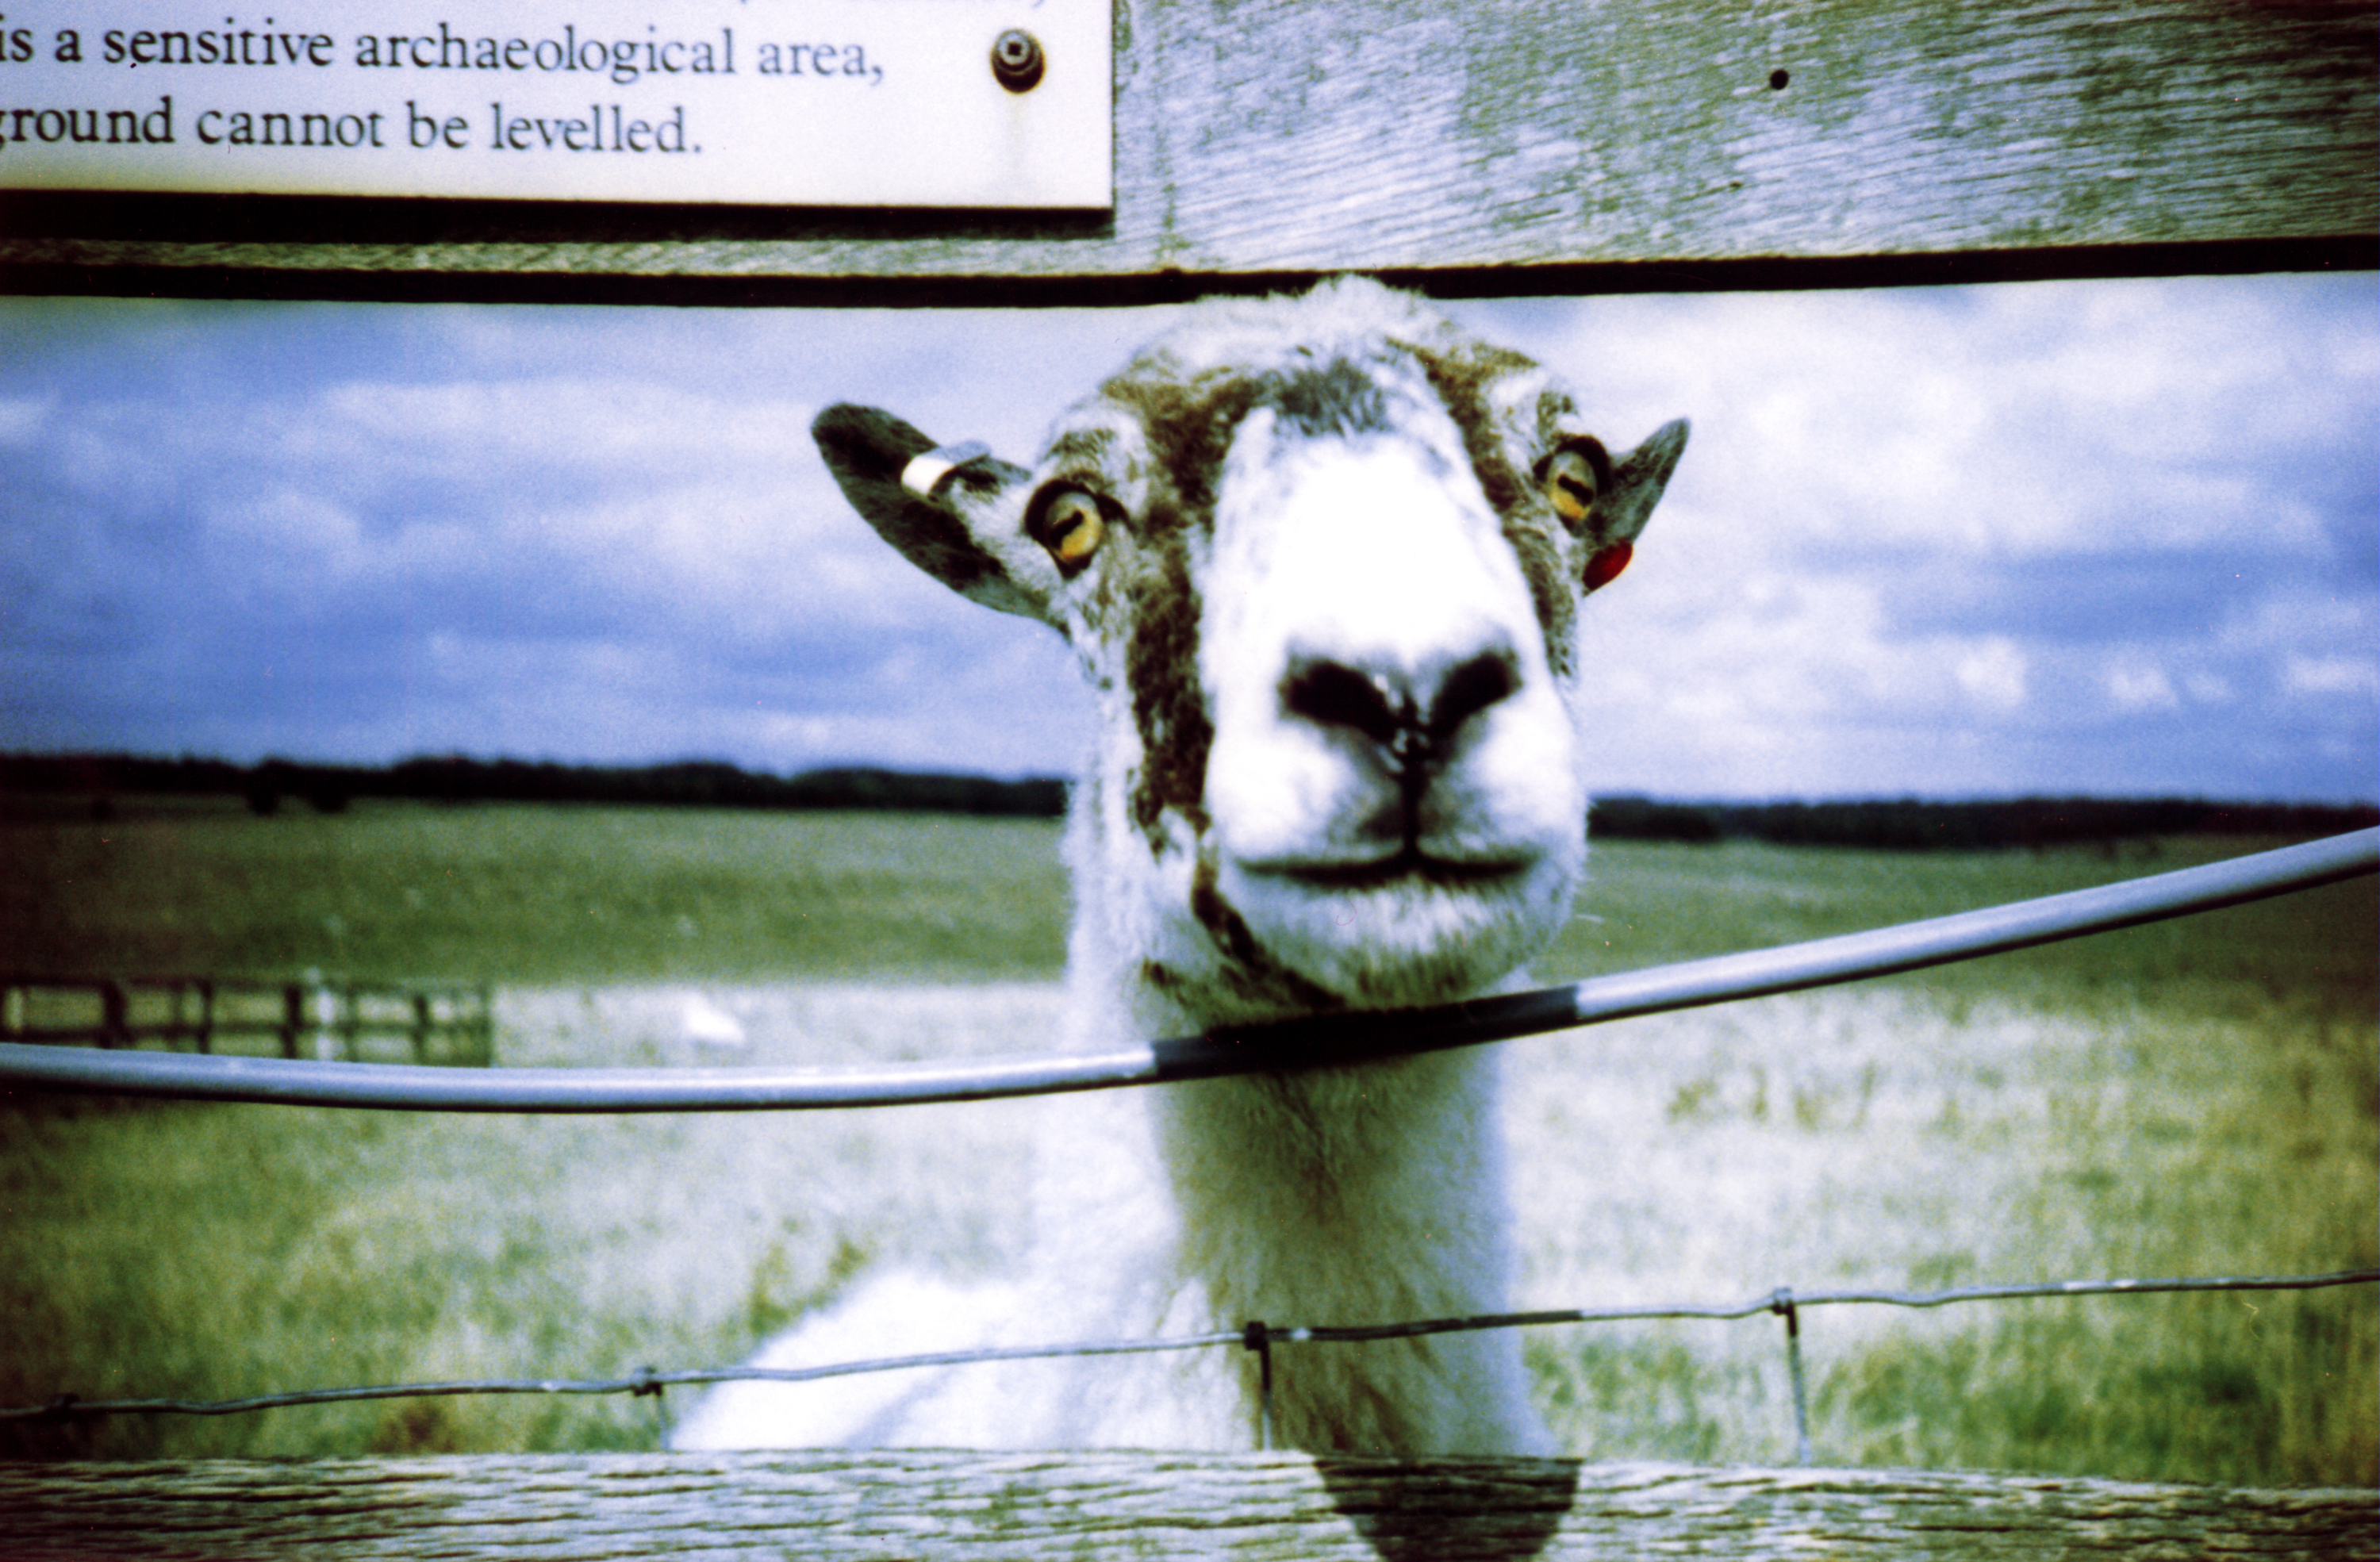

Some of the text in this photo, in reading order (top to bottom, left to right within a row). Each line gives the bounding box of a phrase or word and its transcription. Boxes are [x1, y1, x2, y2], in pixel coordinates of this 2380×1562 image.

[53, 29, 83, 63] a
[103, 16, 335, 67] sensitive
[354, 21, 736, 86] archaeological
[758, 42, 883, 86] area,
[0, 95, 701, 154] round cannot be levelled.
